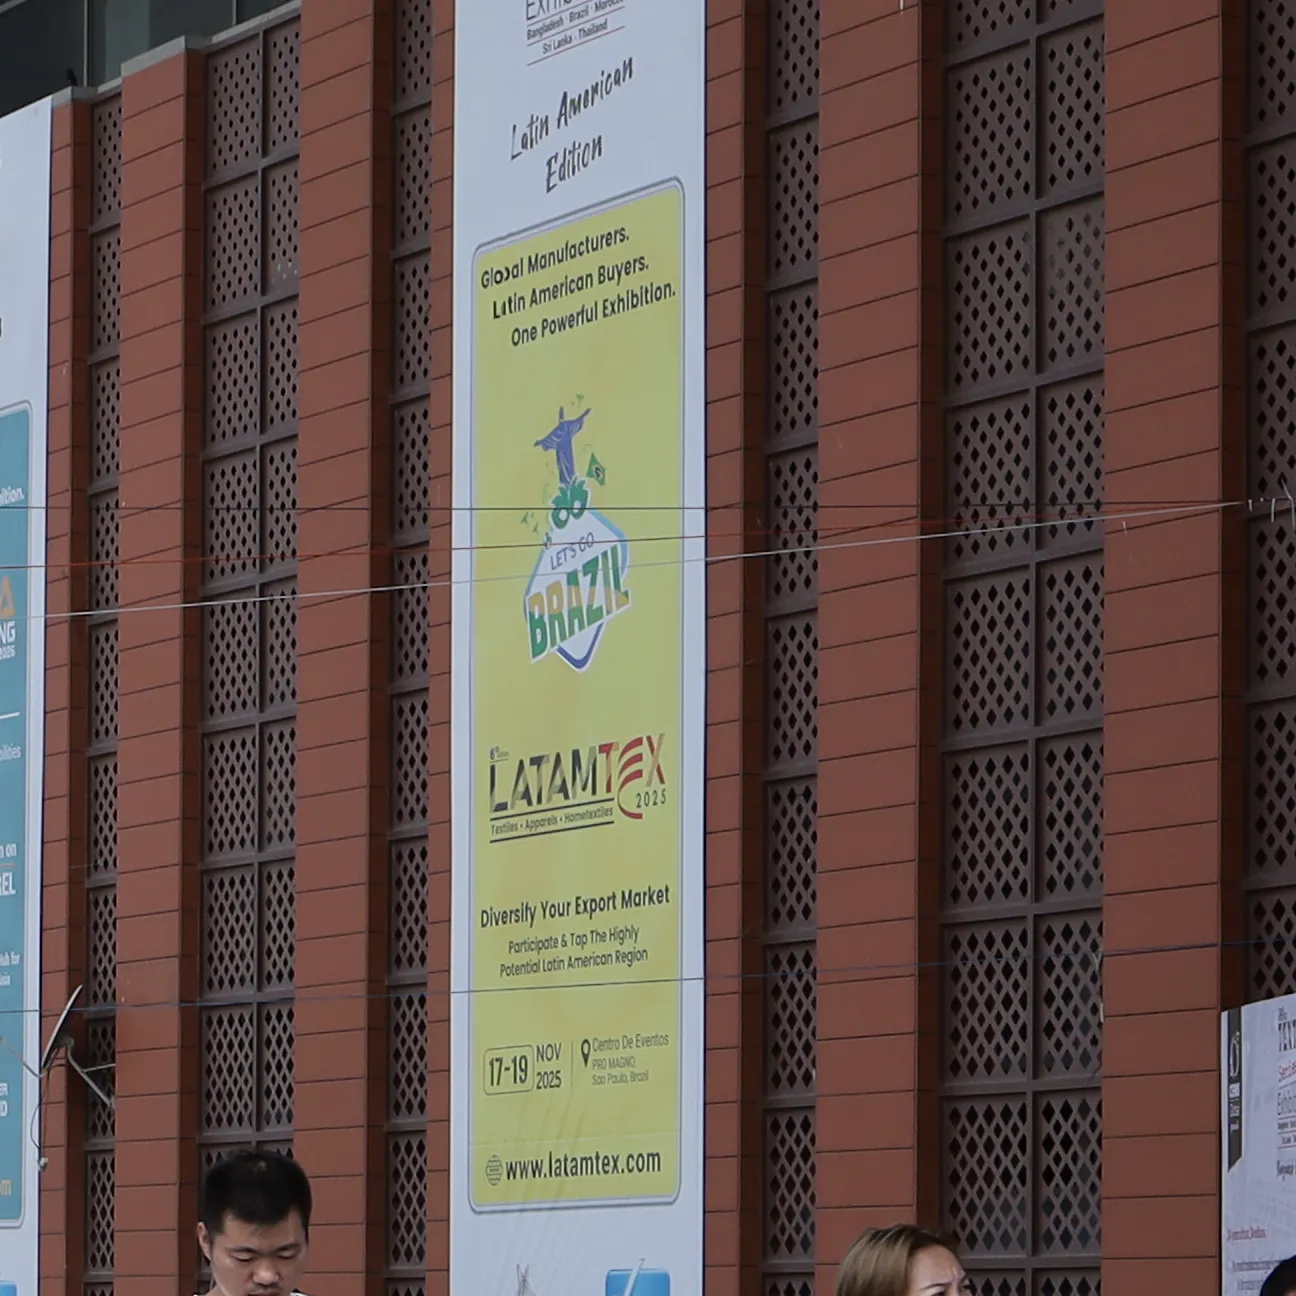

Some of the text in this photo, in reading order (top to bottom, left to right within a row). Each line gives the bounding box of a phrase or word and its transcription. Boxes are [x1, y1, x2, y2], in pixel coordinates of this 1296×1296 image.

[511, 57, 634, 161] Latin American
[546, 136, 602, 193] Edition
[481, 227, 630, 289] Global Manufacturers.
[493, 255, 649, 320] Latin American Buyers.
[511, 281, 676, 347] One Powerful Exhibition.
[550, 532, 595, 570] LET'S GO
[527, 543, 631, 660] BRAZIL
[489, 733, 666, 819] LATAMTEX
[636, 789, 667, 809] 2025
[490, 806, 614, 836] Textiles Apparels Hometextiles
[6, 843, 17, 858] on
[480, 884, 670, 928] Diversify Your Export Market
[508, 924, 640, 955] Participate & Tap The Highly
[500, 947, 648, 978] Potential Latin American Region
[592, 1033, 669, 1053] Centro De Eventos
[489, 1042, 562, 1087] 17-19 NOV
[536, 1070, 562, 1090] 2025
[506, 1151, 661, 1181] www.latamtex.com
